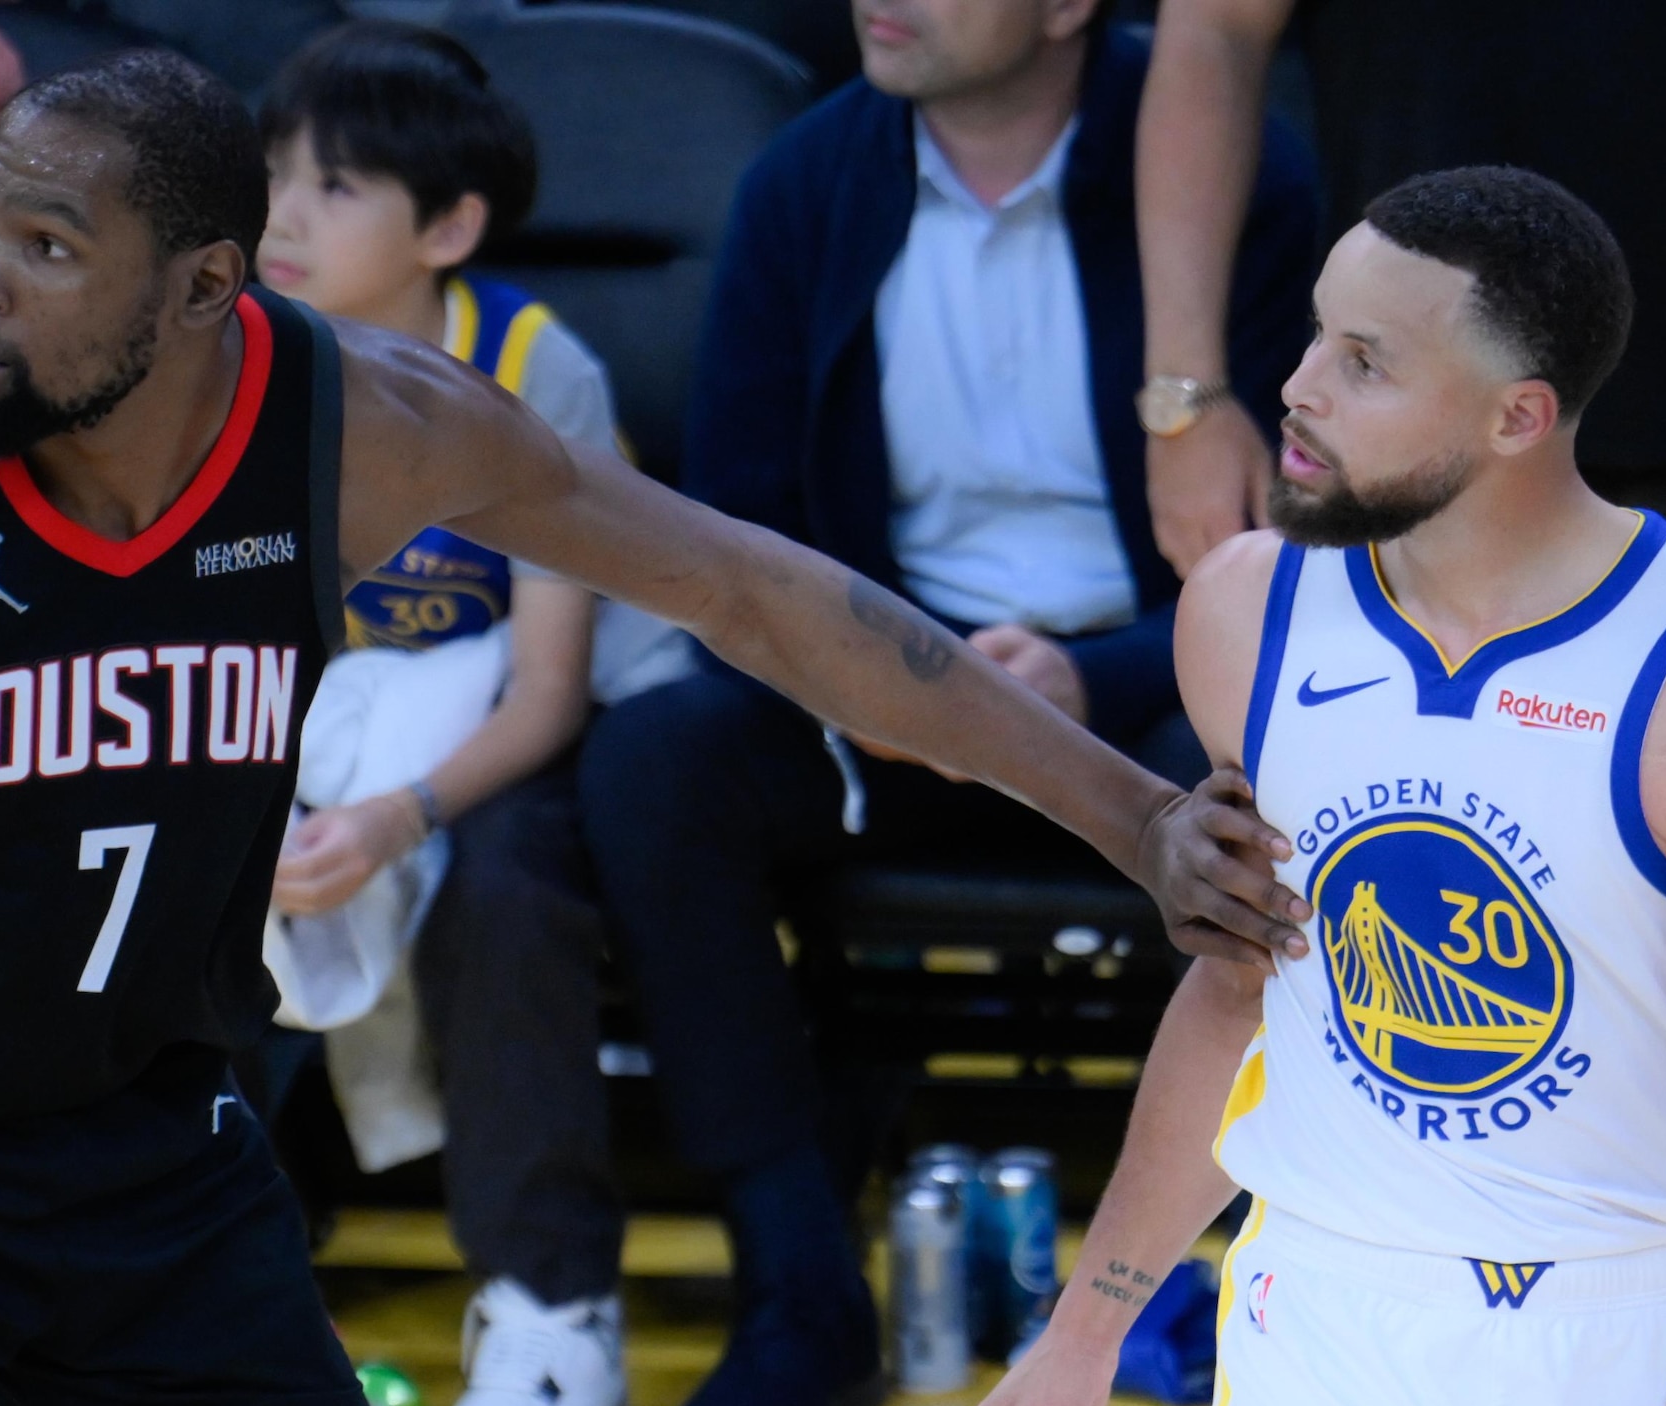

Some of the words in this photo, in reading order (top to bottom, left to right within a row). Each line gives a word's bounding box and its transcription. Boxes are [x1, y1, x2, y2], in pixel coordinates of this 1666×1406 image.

[195, 530, 296, 565] MEMORIAL
[195, 546, 296, 579] HERMANN
[379, 593, 457, 636] 30
[1495, 689, 1607, 734] Rakuten
[1296, 778, 1443, 857] GOLDEN
[1461, 792, 1557, 892] STATE
[76, 823, 156, 993] 7
[1438, 888, 1530, 969] 30
